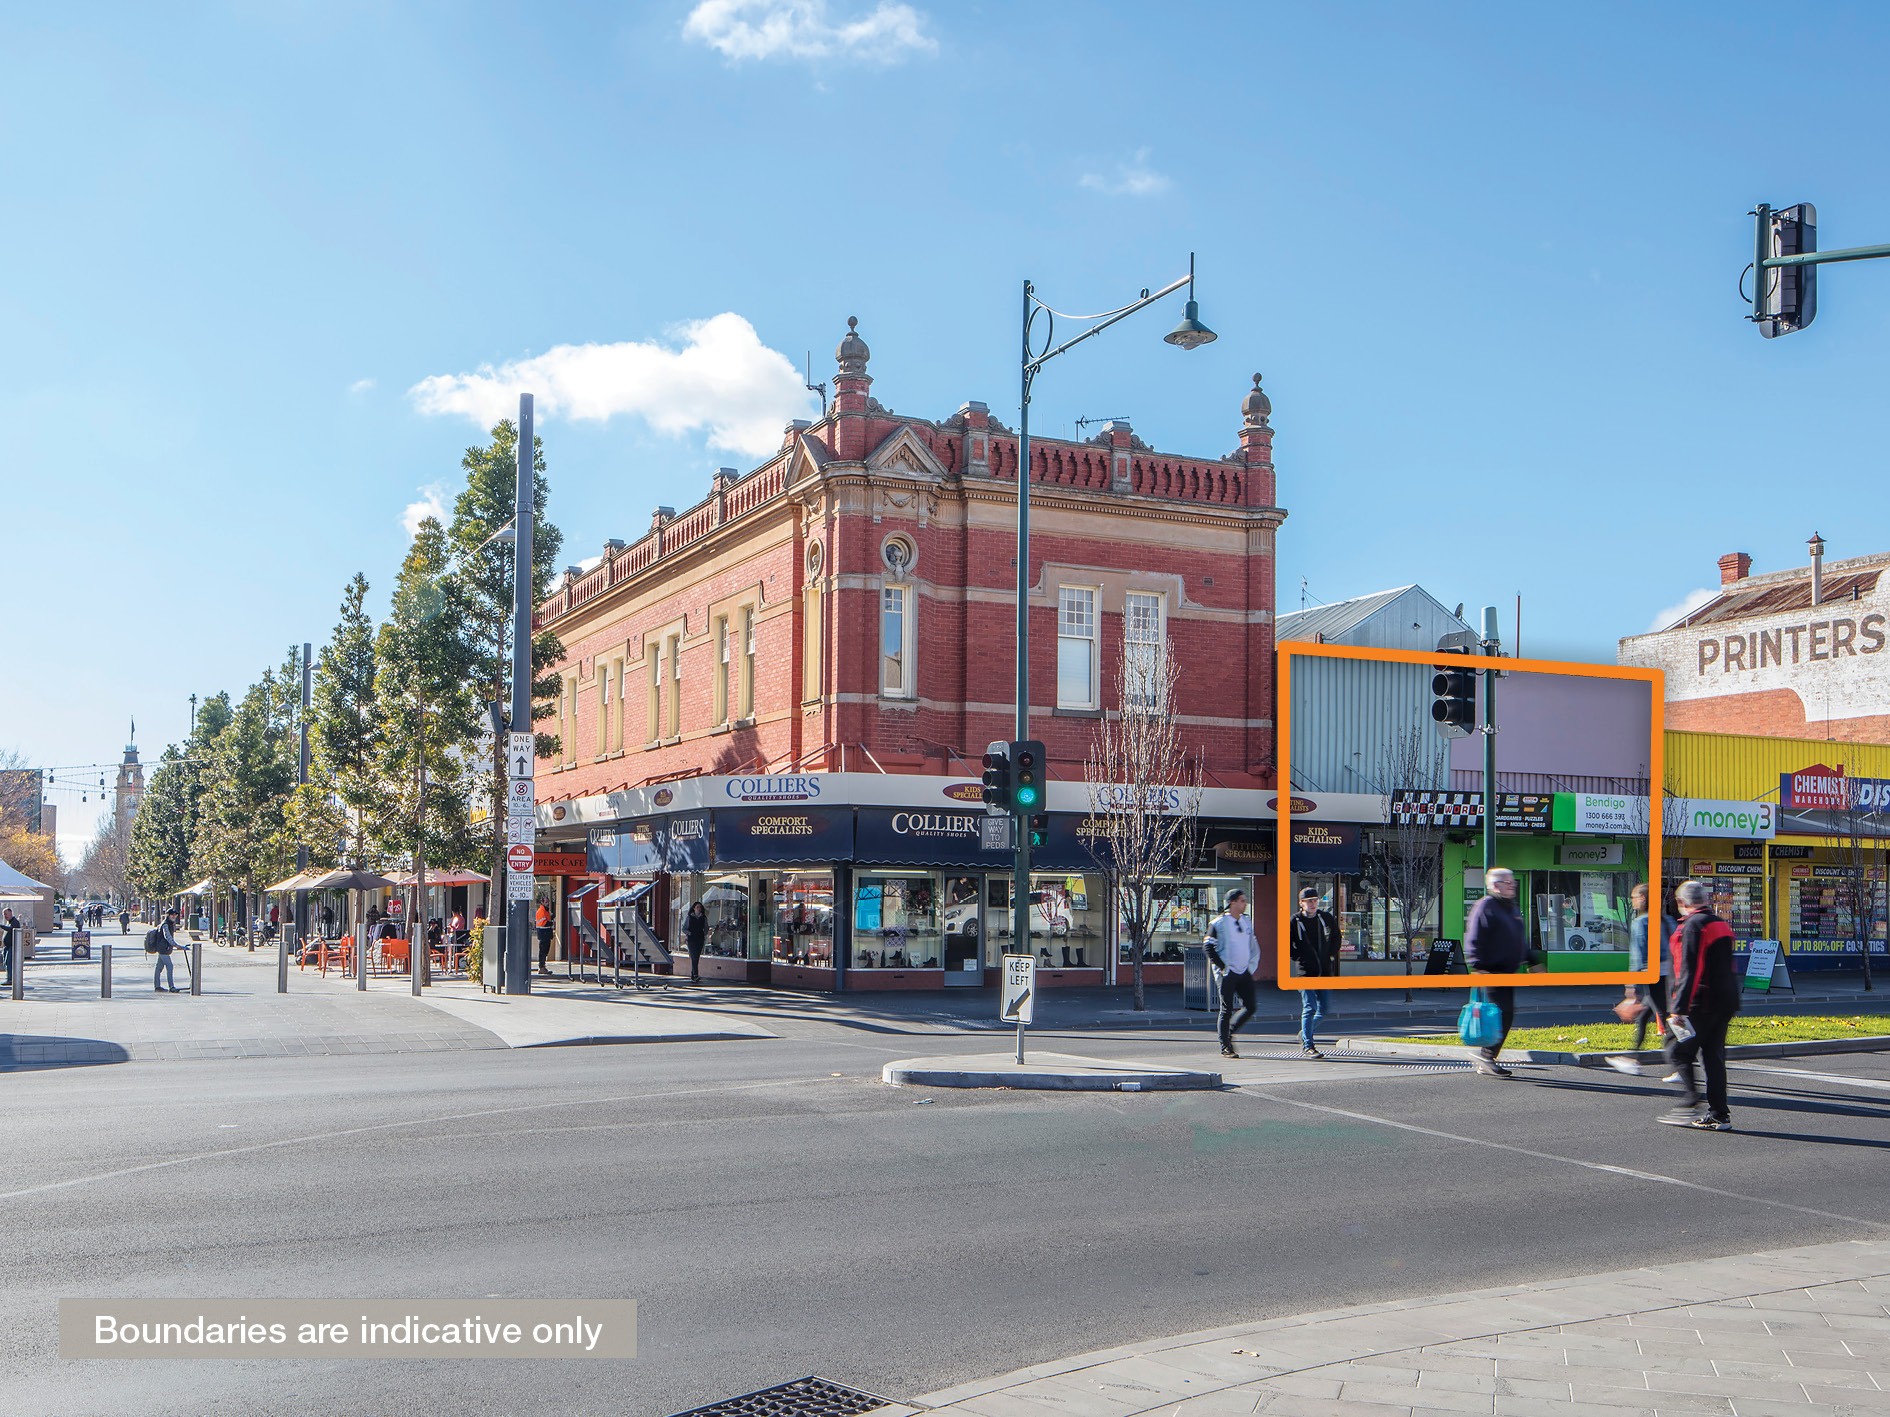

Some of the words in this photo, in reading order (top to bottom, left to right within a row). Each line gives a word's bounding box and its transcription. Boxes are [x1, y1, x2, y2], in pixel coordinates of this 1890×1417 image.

[1699, 613, 1887, 677] PRINTERS
[726, 776, 821, 799] COLLIERS
[1794, 774, 1846, 795] CHEMIST
[1100, 786, 1180, 808] COLERS
[1795, 796, 1847, 806] WAREHOUSE
[1586, 796, 1626, 810] Bendigo
[1395, 804, 1435, 813] GAMES
[1444, 804, 1484, 815] WORLD
[758, 816, 808, 826] COMFORT
[892, 812, 980, 838] COLLIER
[1082, 818, 1126, 828] COMFOT
[1694, 804, 1771, 836] money3
[671, 818, 704, 840] COLLIERS
[751, 826, 813, 836] SPECIALISTS
[1308, 827, 1328, 836] KIDS
[590, 828, 616, 847] COLLIERS
[1294, 834, 1342, 844] SPECIALISTS
[1231, 842, 1266, 851] FITTING
[1738, 846, 1774, 857] DISCOUT
[1775, 846, 1805, 856] CHEMIST
[1224, 850, 1272, 860] SPECIALISTS
[1568, 846, 1608, 861] money3
[534, 858, 560, 866] PPERS
[561, 858, 584, 866] CAFE
[1718, 865, 1746, 873] DISCOUNT
[1732, 940, 1747, 951] FF
[1792, 940, 1802, 952] UP
[1803, 940, 1812, 952] TO
[1812, 940, 1830, 952] 80%
[1831, 940, 1845, 952] OFF
[1010, 961, 1030, 972] KEEP
[1010, 974, 1029, 986] LEFT
